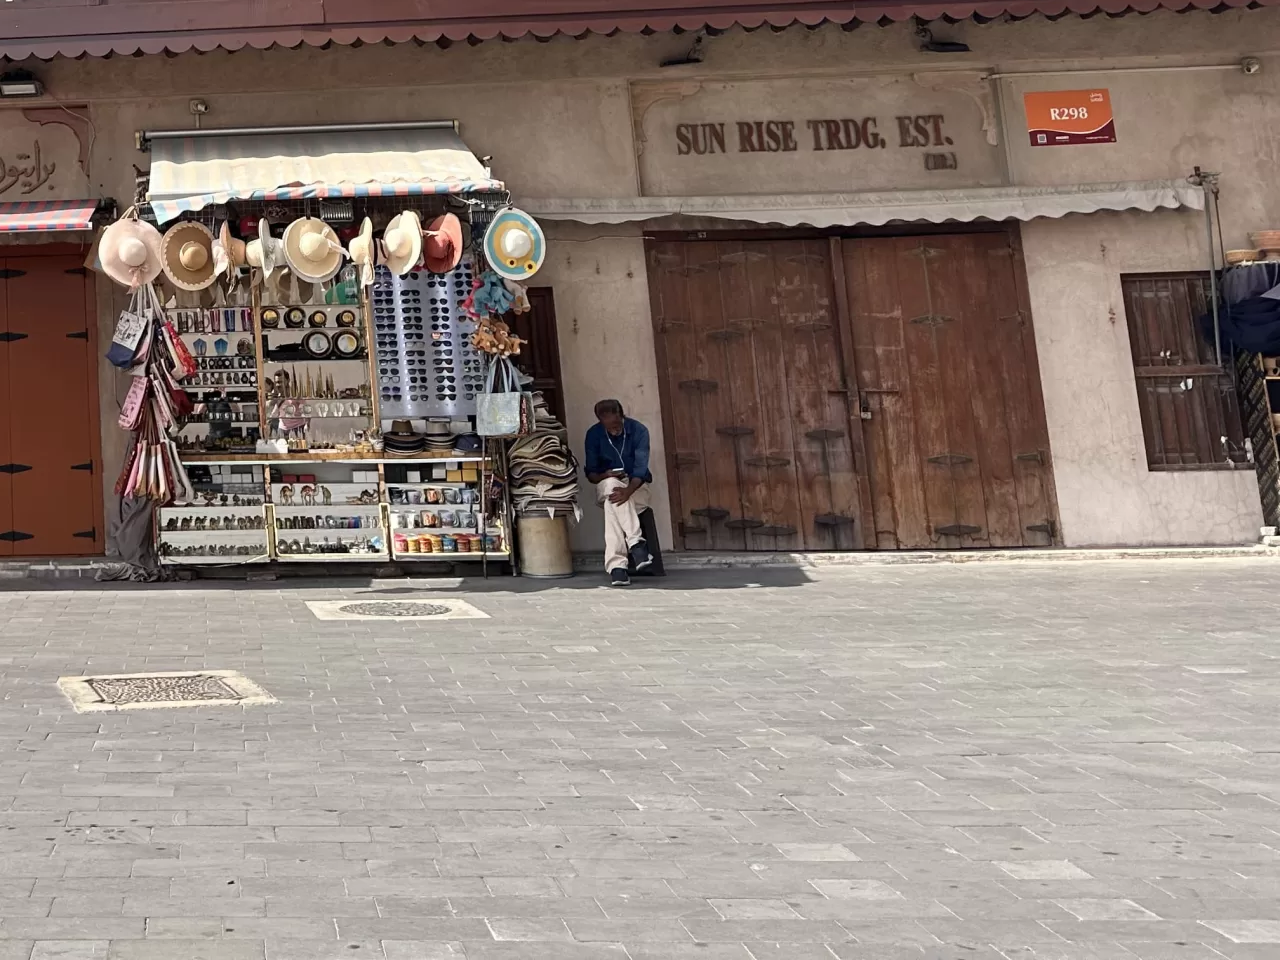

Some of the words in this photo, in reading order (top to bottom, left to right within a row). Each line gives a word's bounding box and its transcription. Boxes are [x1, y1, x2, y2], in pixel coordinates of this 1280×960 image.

[1050, 107, 1088, 120] R298
[676, 122, 726, 155] SUN
[736, 120, 798, 152] RISE
[807, 116, 886, 151] TRDG.
[895, 114, 954, 148] EST.
